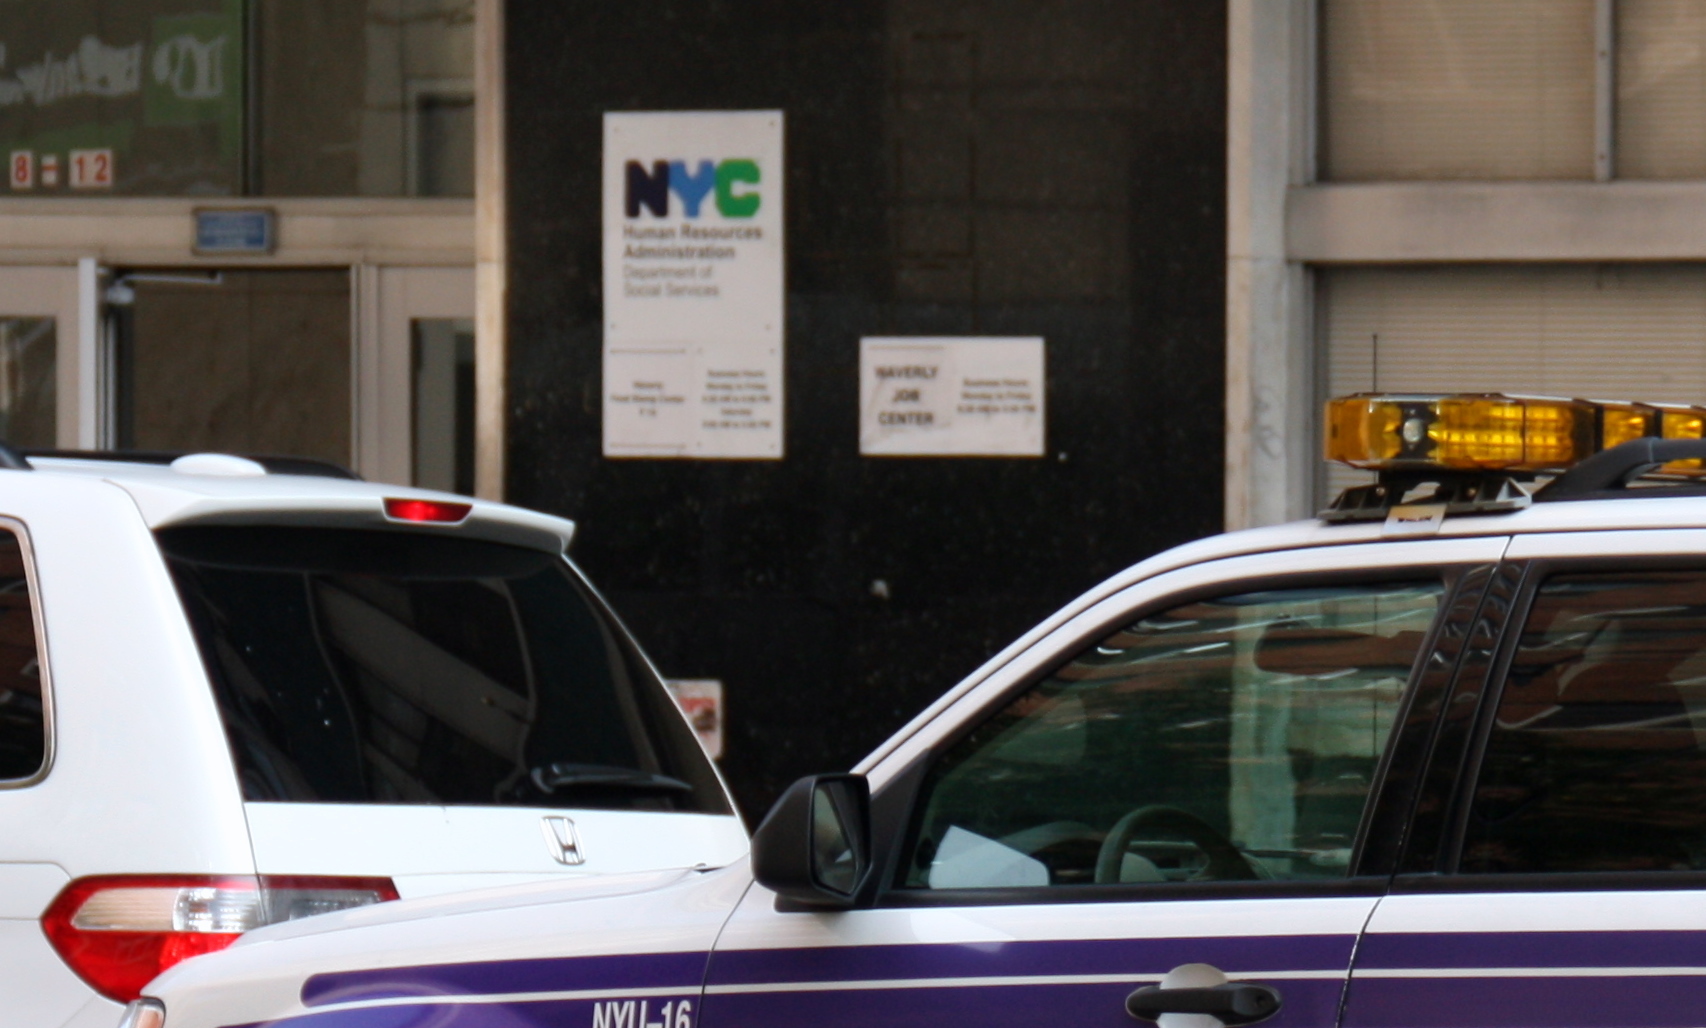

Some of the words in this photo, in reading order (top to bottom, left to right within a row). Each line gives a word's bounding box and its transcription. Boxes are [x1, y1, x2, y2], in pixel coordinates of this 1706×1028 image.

[624, 157, 761, 218] NYC
[624, 224, 677, 240] Human
[680, 223, 763, 240] Resources
[623, 244, 736, 260] Administration
[878, 411, 935, 426] CENTER
